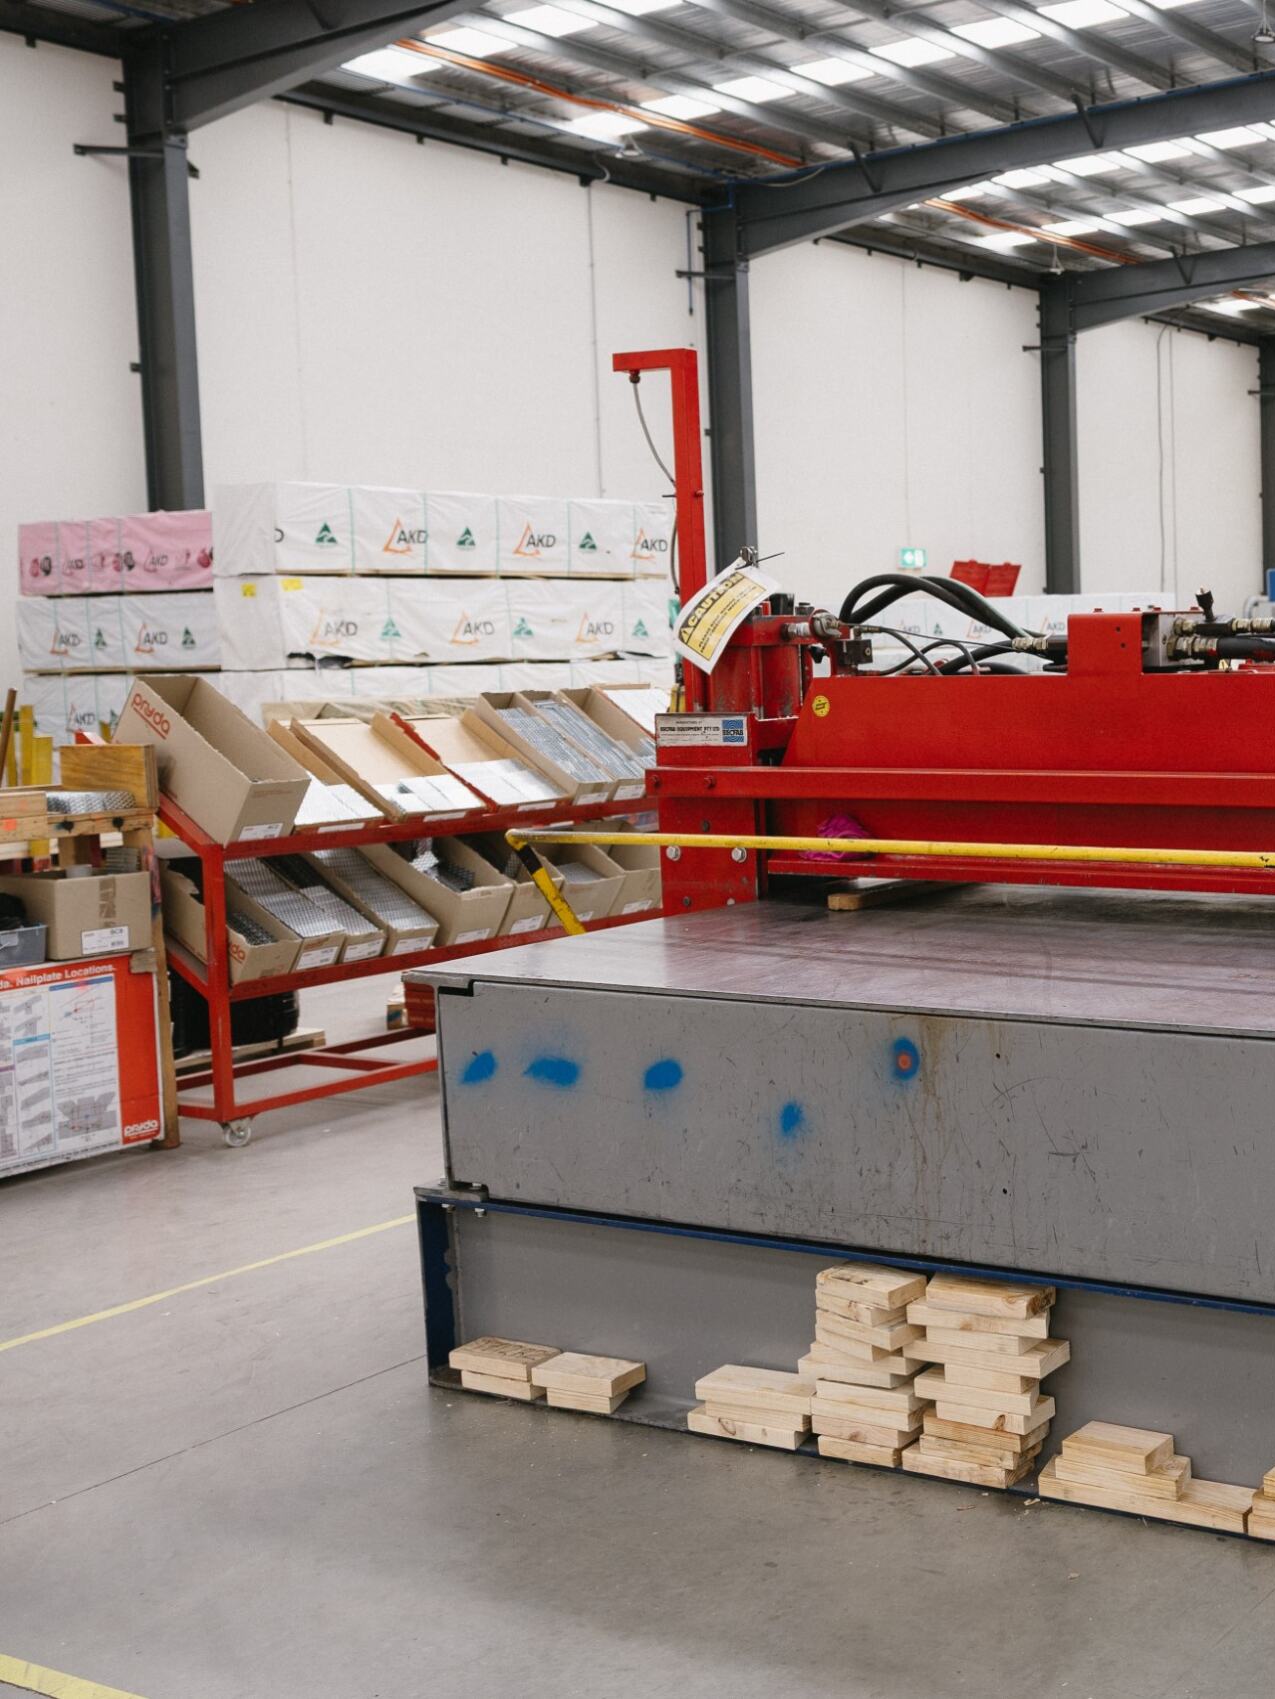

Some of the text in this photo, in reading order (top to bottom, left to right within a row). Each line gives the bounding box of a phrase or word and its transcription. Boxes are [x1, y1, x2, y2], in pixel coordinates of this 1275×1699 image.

[397, 530, 427, 544] AKD
[526, 534, 556, 548] AKD
[641, 538, 668, 552] AKD
[687, 571, 744, 628] CAUTION
[324, 621, 358, 637] AKD
[463, 620, 495, 636] AKD
[586, 621, 614, 636] AKD
[59, 634, 82, 648] AKD
[143, 631, 168, 645] AKD
[131, 694, 171, 736] pryda
[16, 972, 63, 987] Nailplate
[65, 964, 116, 979] Locations.
